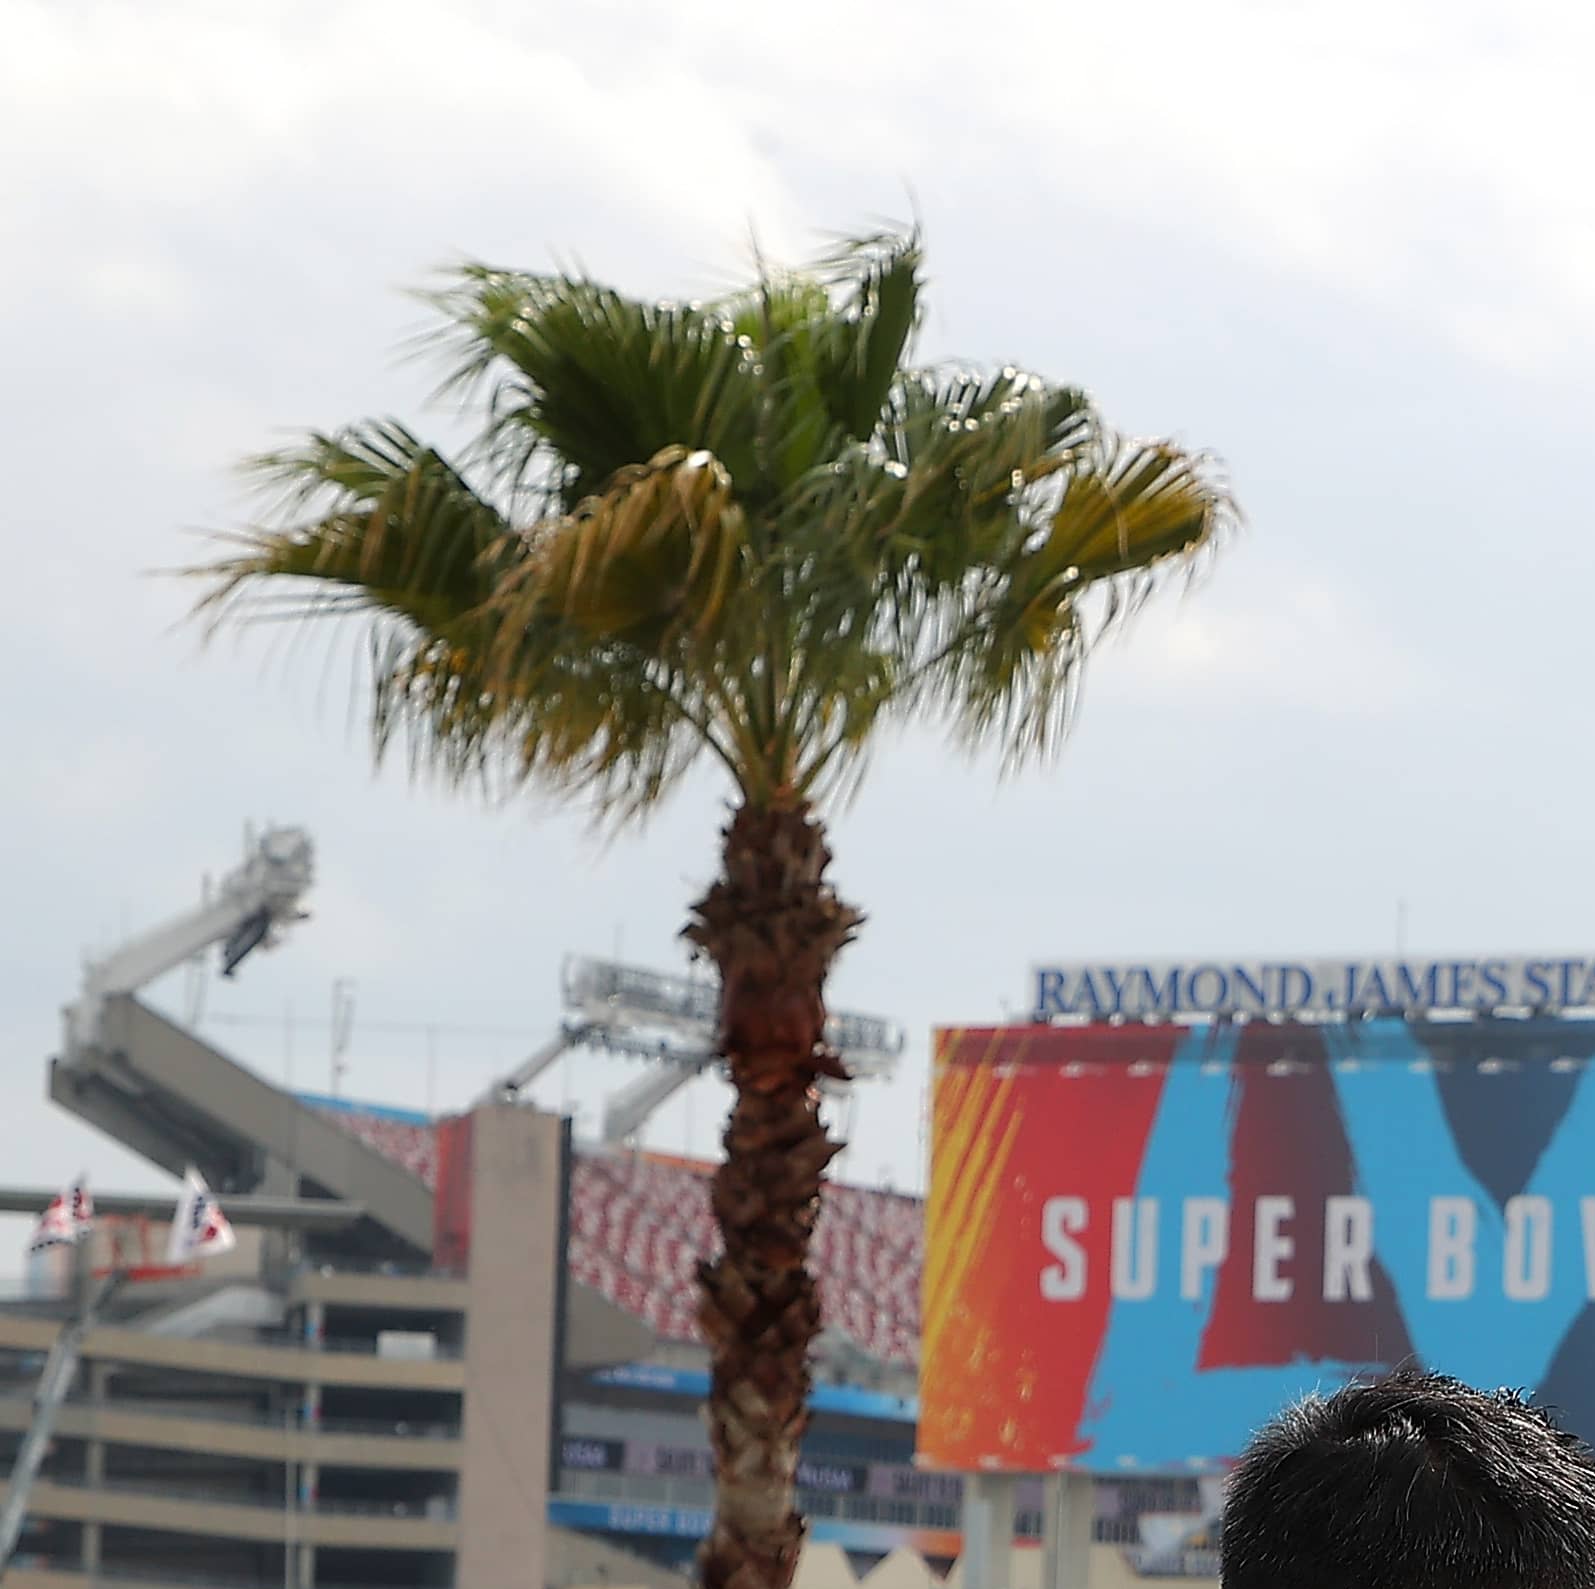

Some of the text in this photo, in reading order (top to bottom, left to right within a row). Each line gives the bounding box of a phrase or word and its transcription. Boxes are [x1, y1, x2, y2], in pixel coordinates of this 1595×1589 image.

[1036, 962, 1314, 1012] RAYMOND
[1326, 958, 1507, 1007] JAMES
[1040, 1195, 1374, 1301] SUPER
